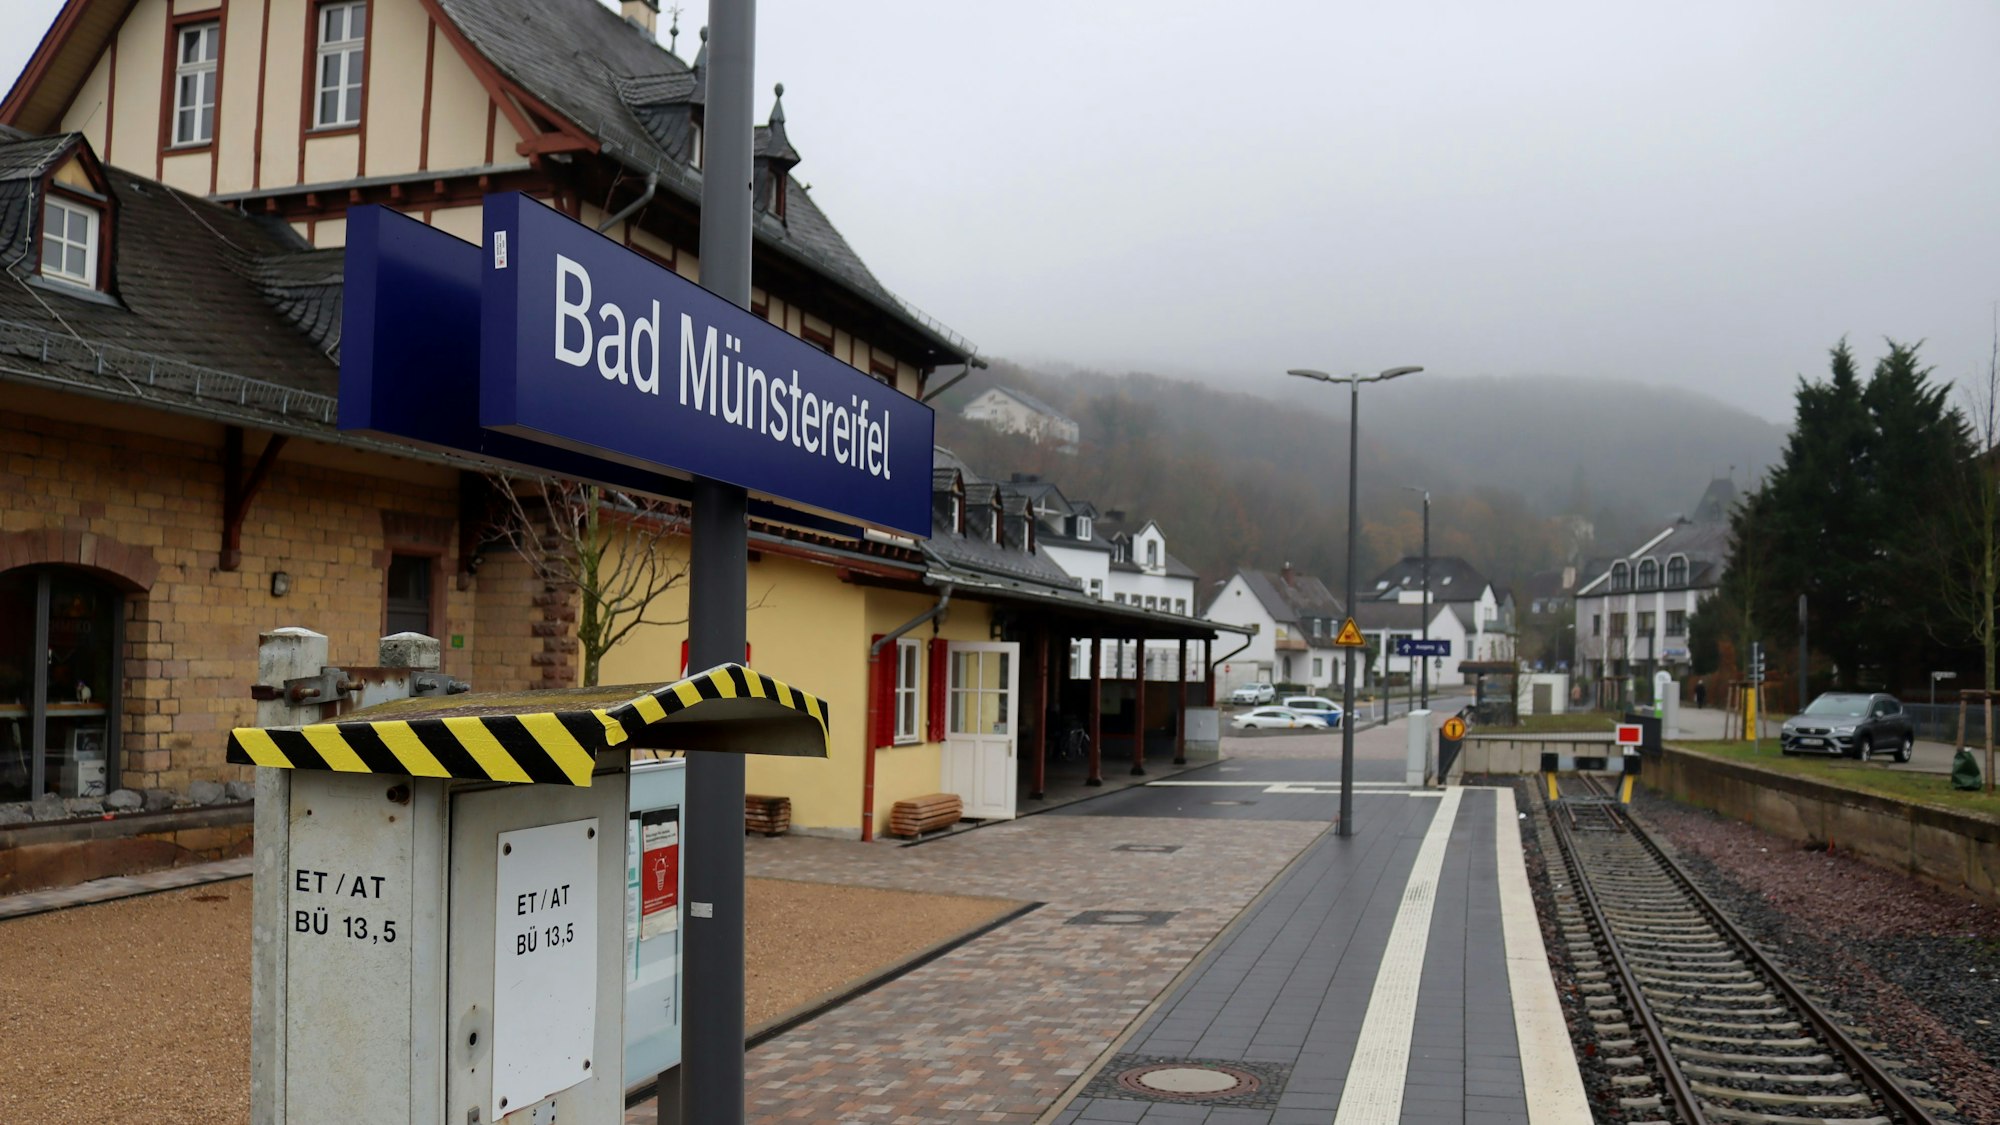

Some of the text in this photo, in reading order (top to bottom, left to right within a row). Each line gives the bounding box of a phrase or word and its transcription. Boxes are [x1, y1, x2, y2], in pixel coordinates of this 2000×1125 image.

[554, 253, 891, 480] Bad Münstereifel
[295, 906, 397, 945] BÜ 13,5
[516, 922, 574, 956] BÜ 13,5
